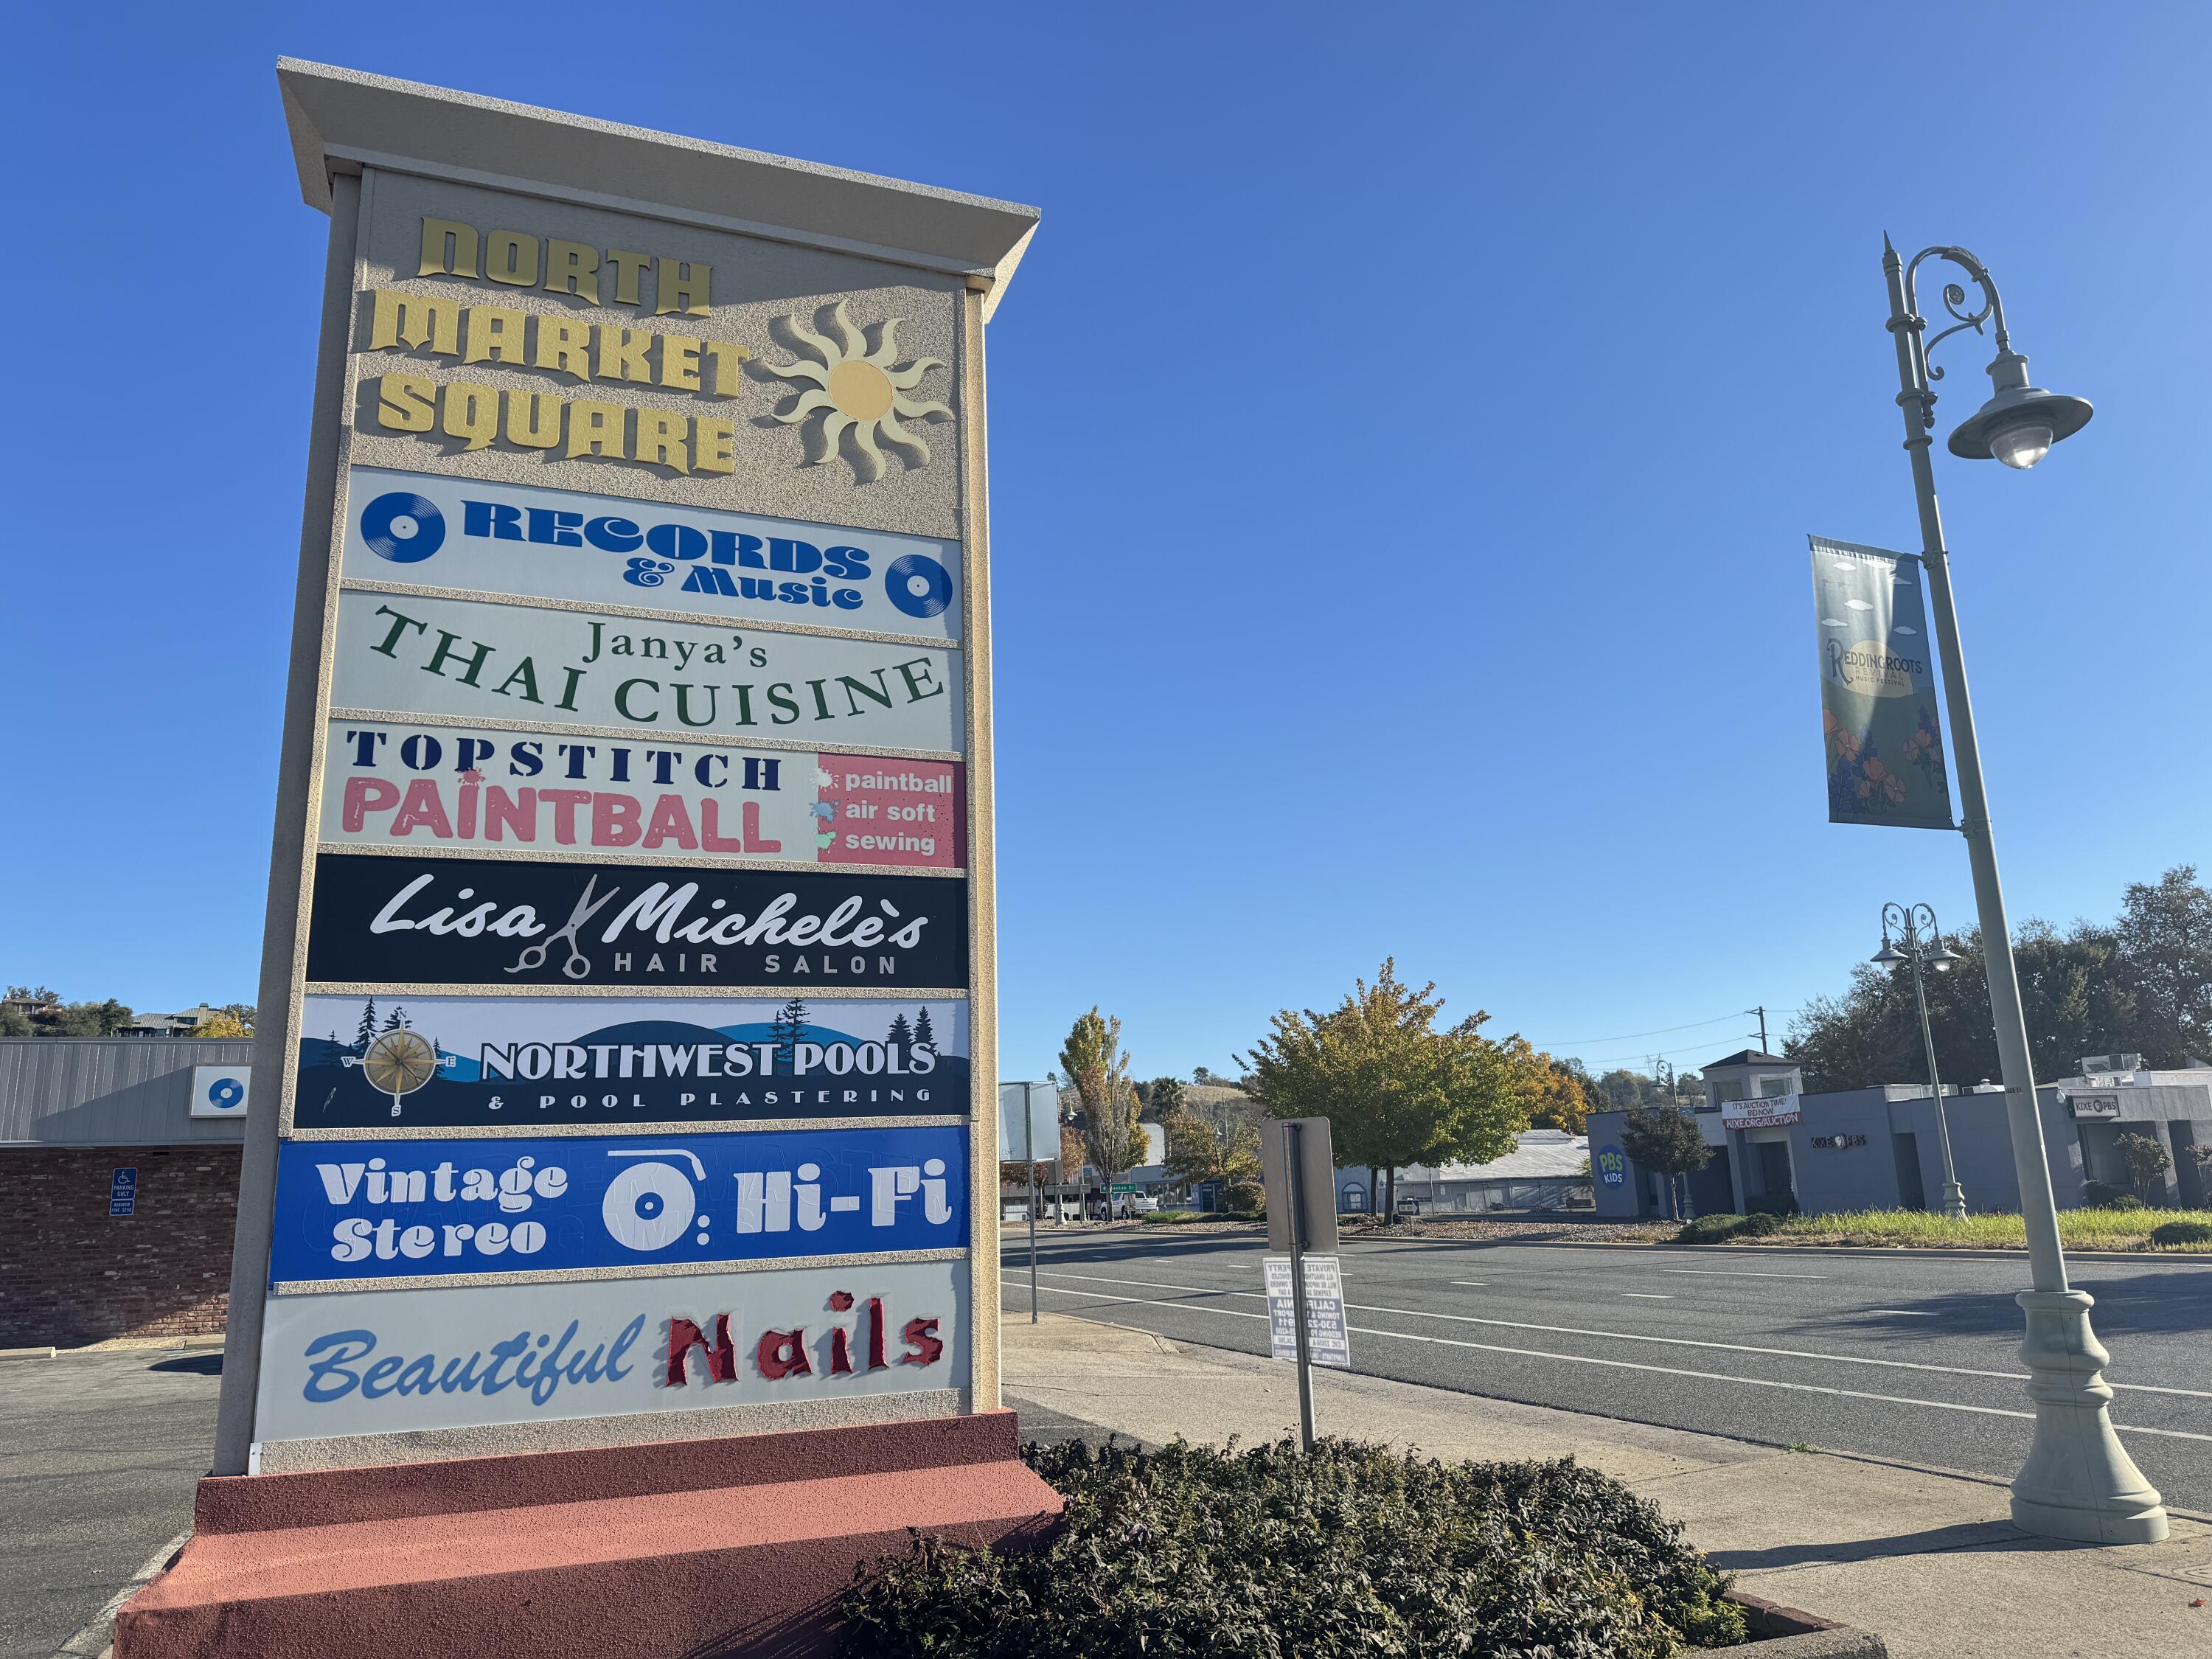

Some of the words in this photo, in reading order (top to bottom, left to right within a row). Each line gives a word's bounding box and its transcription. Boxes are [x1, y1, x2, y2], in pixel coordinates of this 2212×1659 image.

[417, 218, 712, 317] NORTH
[367, 288, 750, 397] MARKET
[378, 372, 734, 476] SQUARE
[460, 500, 872, 580] RECORDS
[624, 557, 673, 587] &
[681, 565, 865, 610] Music
[582, 622, 767, 671] Janya's
[370, 605, 587, 712] THAI
[614, 657, 943, 726] CUISINE
[1855, 667, 1902, 680] REVIVAL
[1877, 678, 1905, 686] FESTIVAL
[346, 731, 782, 792] TOPSTITCH
[846, 771, 952, 793] paintball
[846, 800, 878, 819] air
[887, 803, 936, 822] soft
[846, 832, 935, 856] sewing
[370, 874, 546, 937] Lisa
[614, 953, 718, 973] HAIR
[765, 953, 895, 974] SALON
[342, 1057, 354, 1067] W
[447, 1056, 456, 1066] E
[481, 1042, 786, 1081] NORTHWEST
[793, 1041, 936, 1077] POOLS
[393, 1106, 400, 1116] S
[488, 1096, 504, 1110] &
[540, 1094, 646, 1109] POOL
[681, 1089, 931, 1107] PLASTERING
[1743, 1100, 1770, 1109] AUCTION
[1770, 1098, 1787, 1107] TIME!
[2076, 1102, 2093, 1111] KIXE
[2104, 1102, 2116, 1110] PBS
[1726, 1113, 1799, 1128] KIXE.ORG/AUCTION
[1846, 1135, 1865, 1146] PBS
[1599, 1152, 1623, 1172] PBS
[316, 1156, 568, 1213] Vintage
[1604, 1173, 1623, 1184] KIDS
[733, 1158, 953, 1234] Hi-Fi
[330, 1218, 547, 1262] Stereo
[302, 1312, 647, 1406] Beautiful
[666, 1290, 945, 1389] Nails
